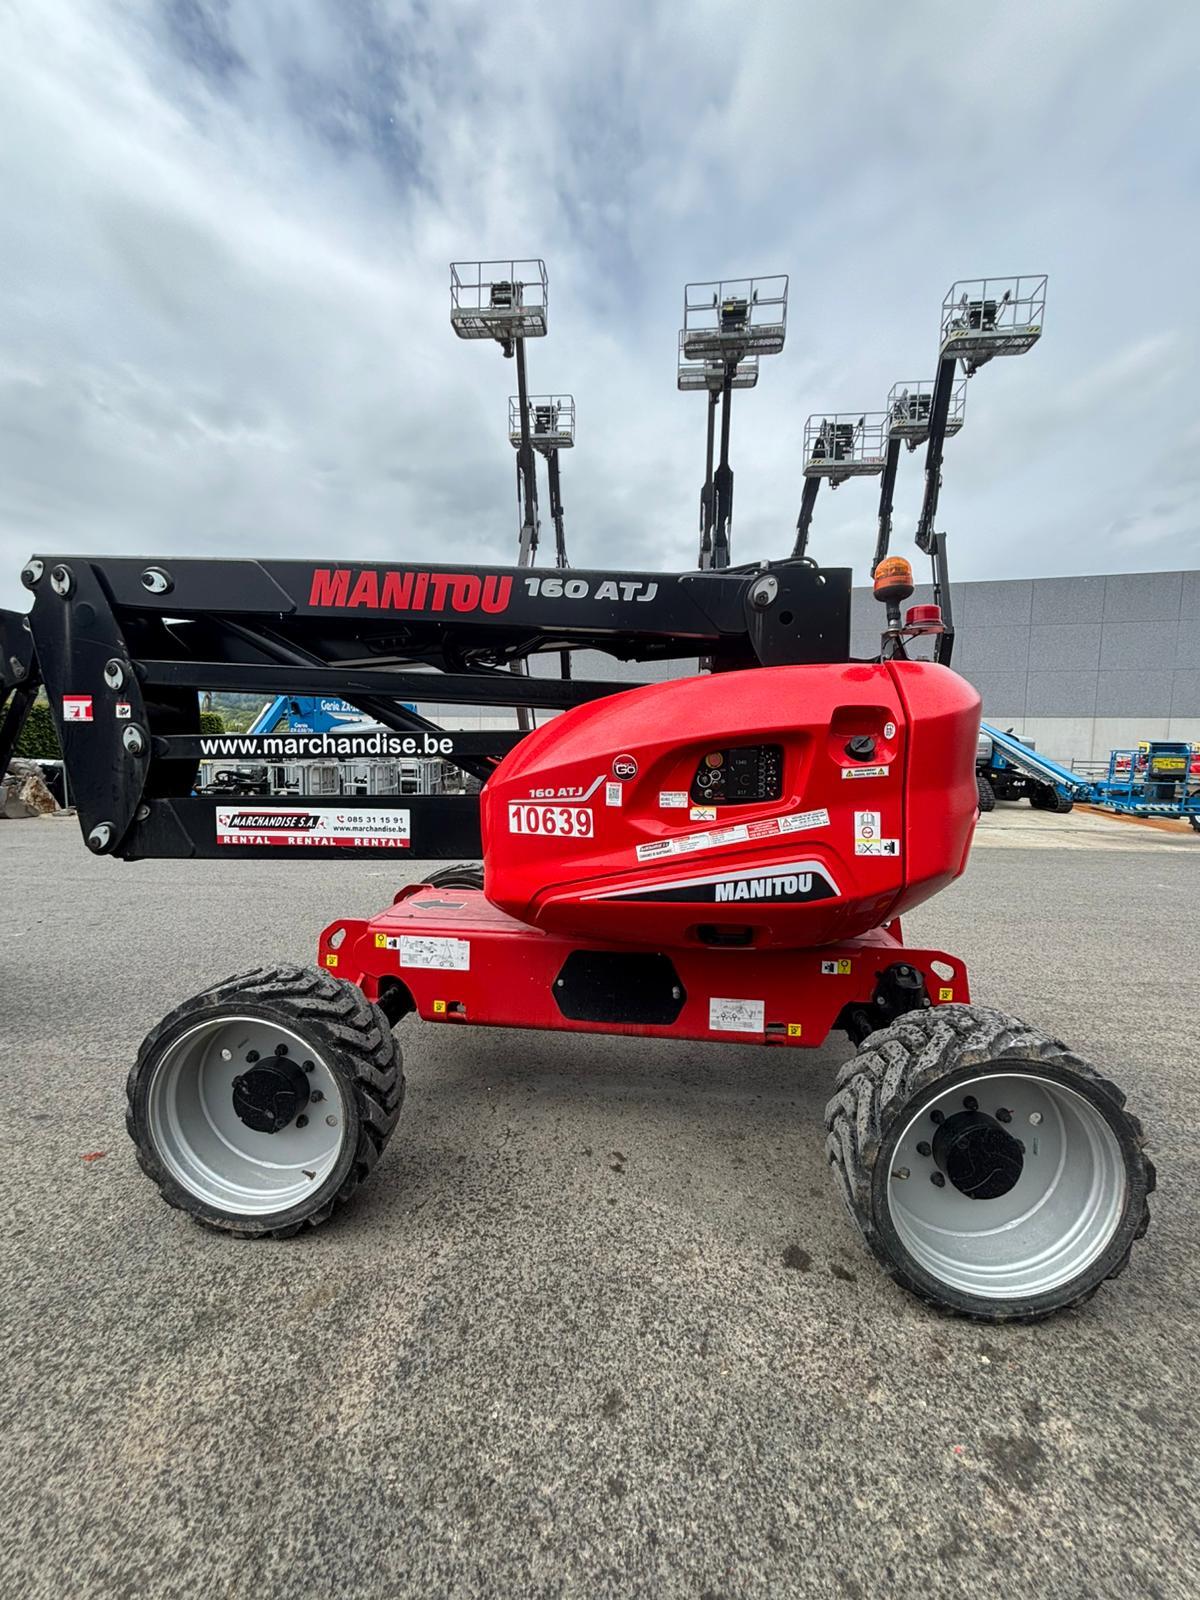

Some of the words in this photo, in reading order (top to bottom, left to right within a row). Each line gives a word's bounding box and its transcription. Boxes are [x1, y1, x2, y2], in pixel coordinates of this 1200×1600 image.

[308, 569, 513, 614] MANITOU
[524, 577, 589, 599] 160
[595, 581, 659, 602] ATJ
[320, 700, 339, 712] Genie
[200, 733, 453, 754] www.marchandise.be
[529, 788, 555, 798] 160
[557, 786, 583, 797] ATJ
[231, 815, 297, 827] MARCHANDISE
[298, 818, 316, 828] S.A.
[512, 806, 592, 836] 10639
[333, 825, 407, 833] www.marchandise.be
[223, 835, 271, 844] RENTAL
[288, 837, 337, 846] RENTAL
[354, 838, 403, 847] RENTAL
[715, 873, 813, 902] MANITOU
